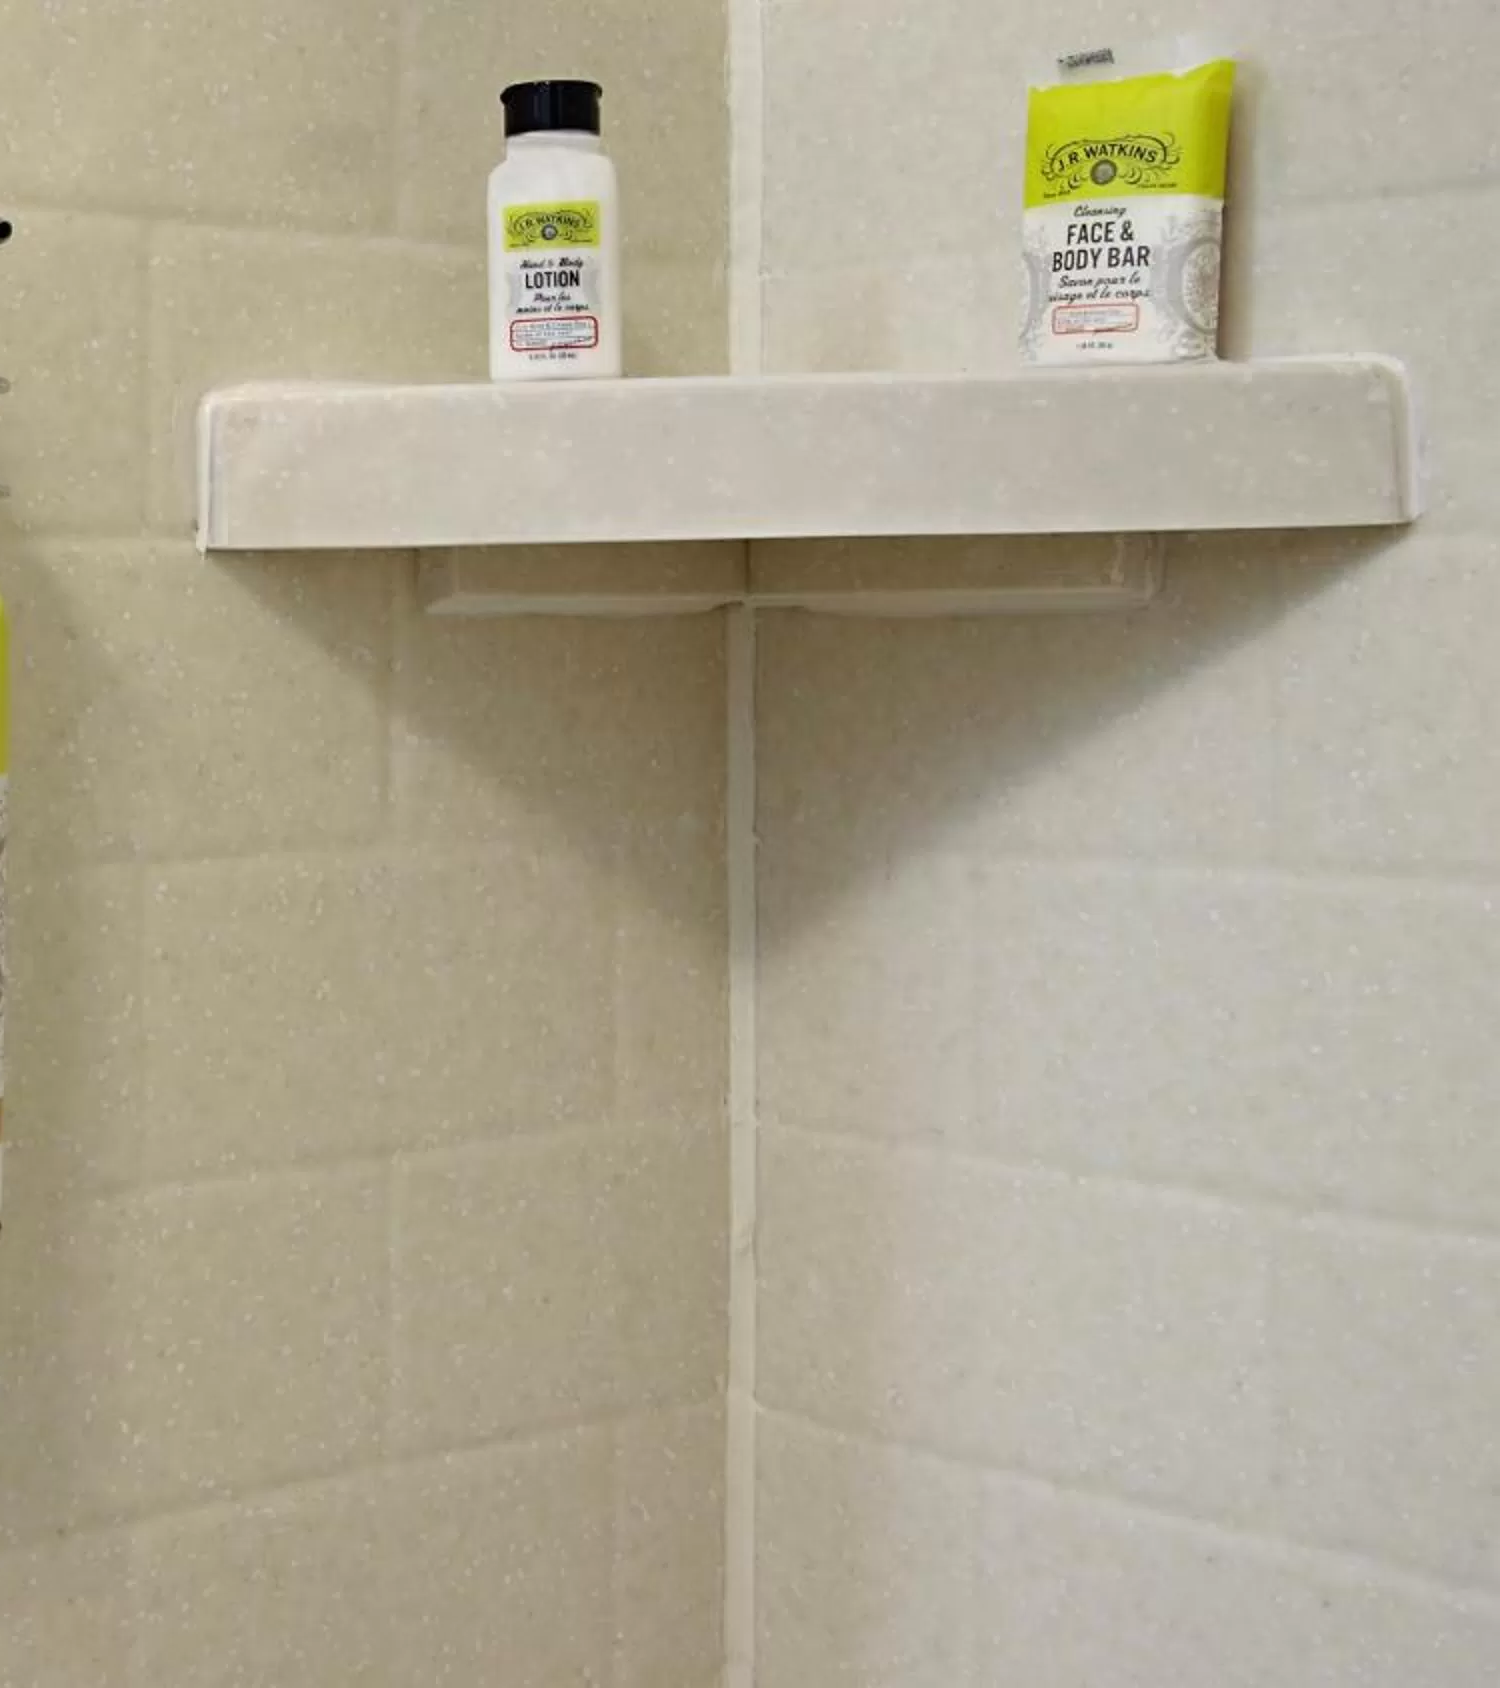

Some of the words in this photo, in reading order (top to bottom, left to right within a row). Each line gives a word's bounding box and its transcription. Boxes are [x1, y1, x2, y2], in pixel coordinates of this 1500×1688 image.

[1083, 143, 1158, 163] WATKINS
[1074, 205, 1127, 218] Cleansing
[1067, 221, 1116, 245] FACE
[1120, 220, 1135, 242] &
[1052, 248, 1103, 272] BODY
[1107, 245, 1151, 268] BAR
[525, 270, 580, 289] LOTION
[1059, 275, 1093, 289] Savon
[1095, 277, 1126, 291] pour
[1129, 271, 1141, 285] le
[1048, 289, 1083, 304] visage
[1086, 286, 1099, 299] et
[1100, 285, 1113, 299] le
